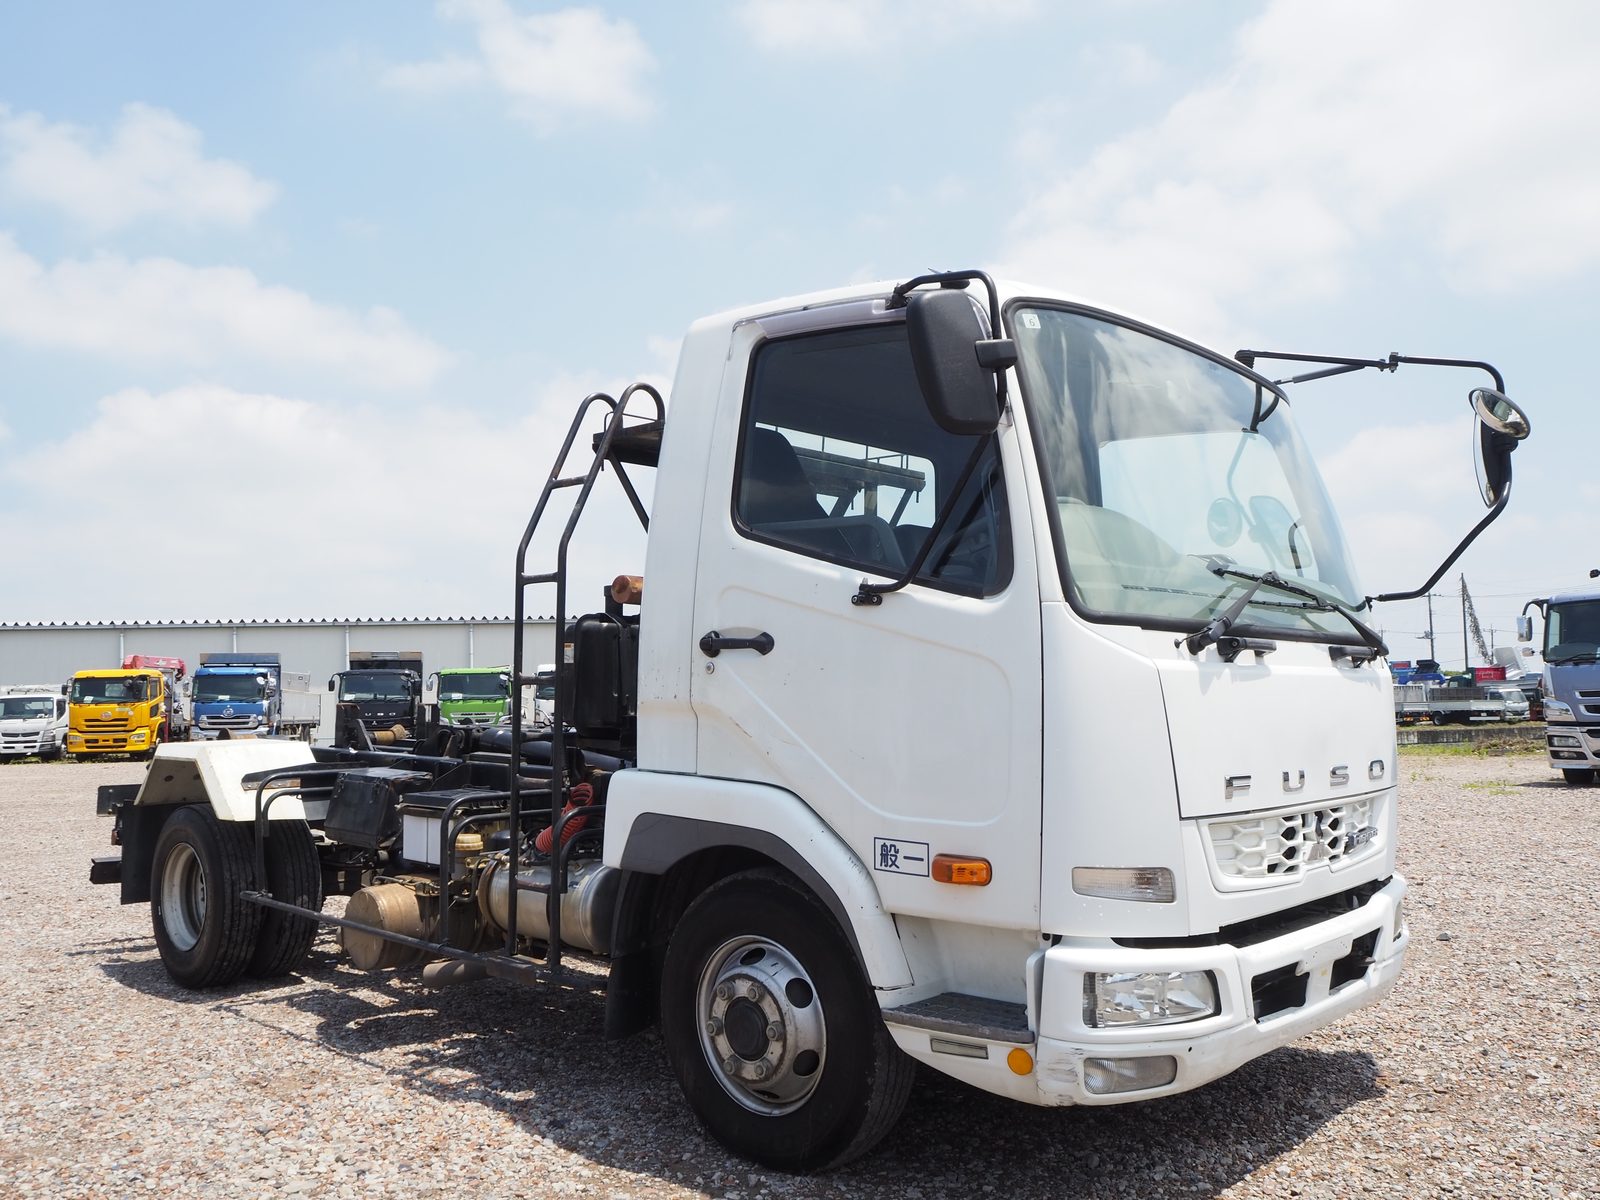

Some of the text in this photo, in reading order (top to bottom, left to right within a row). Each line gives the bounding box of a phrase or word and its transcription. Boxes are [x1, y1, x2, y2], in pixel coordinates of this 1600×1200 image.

[1029, 318, 1035, 327] 6
[1224, 759, 1385, 800] FUSO
[880, 842, 924, 869] 般一
